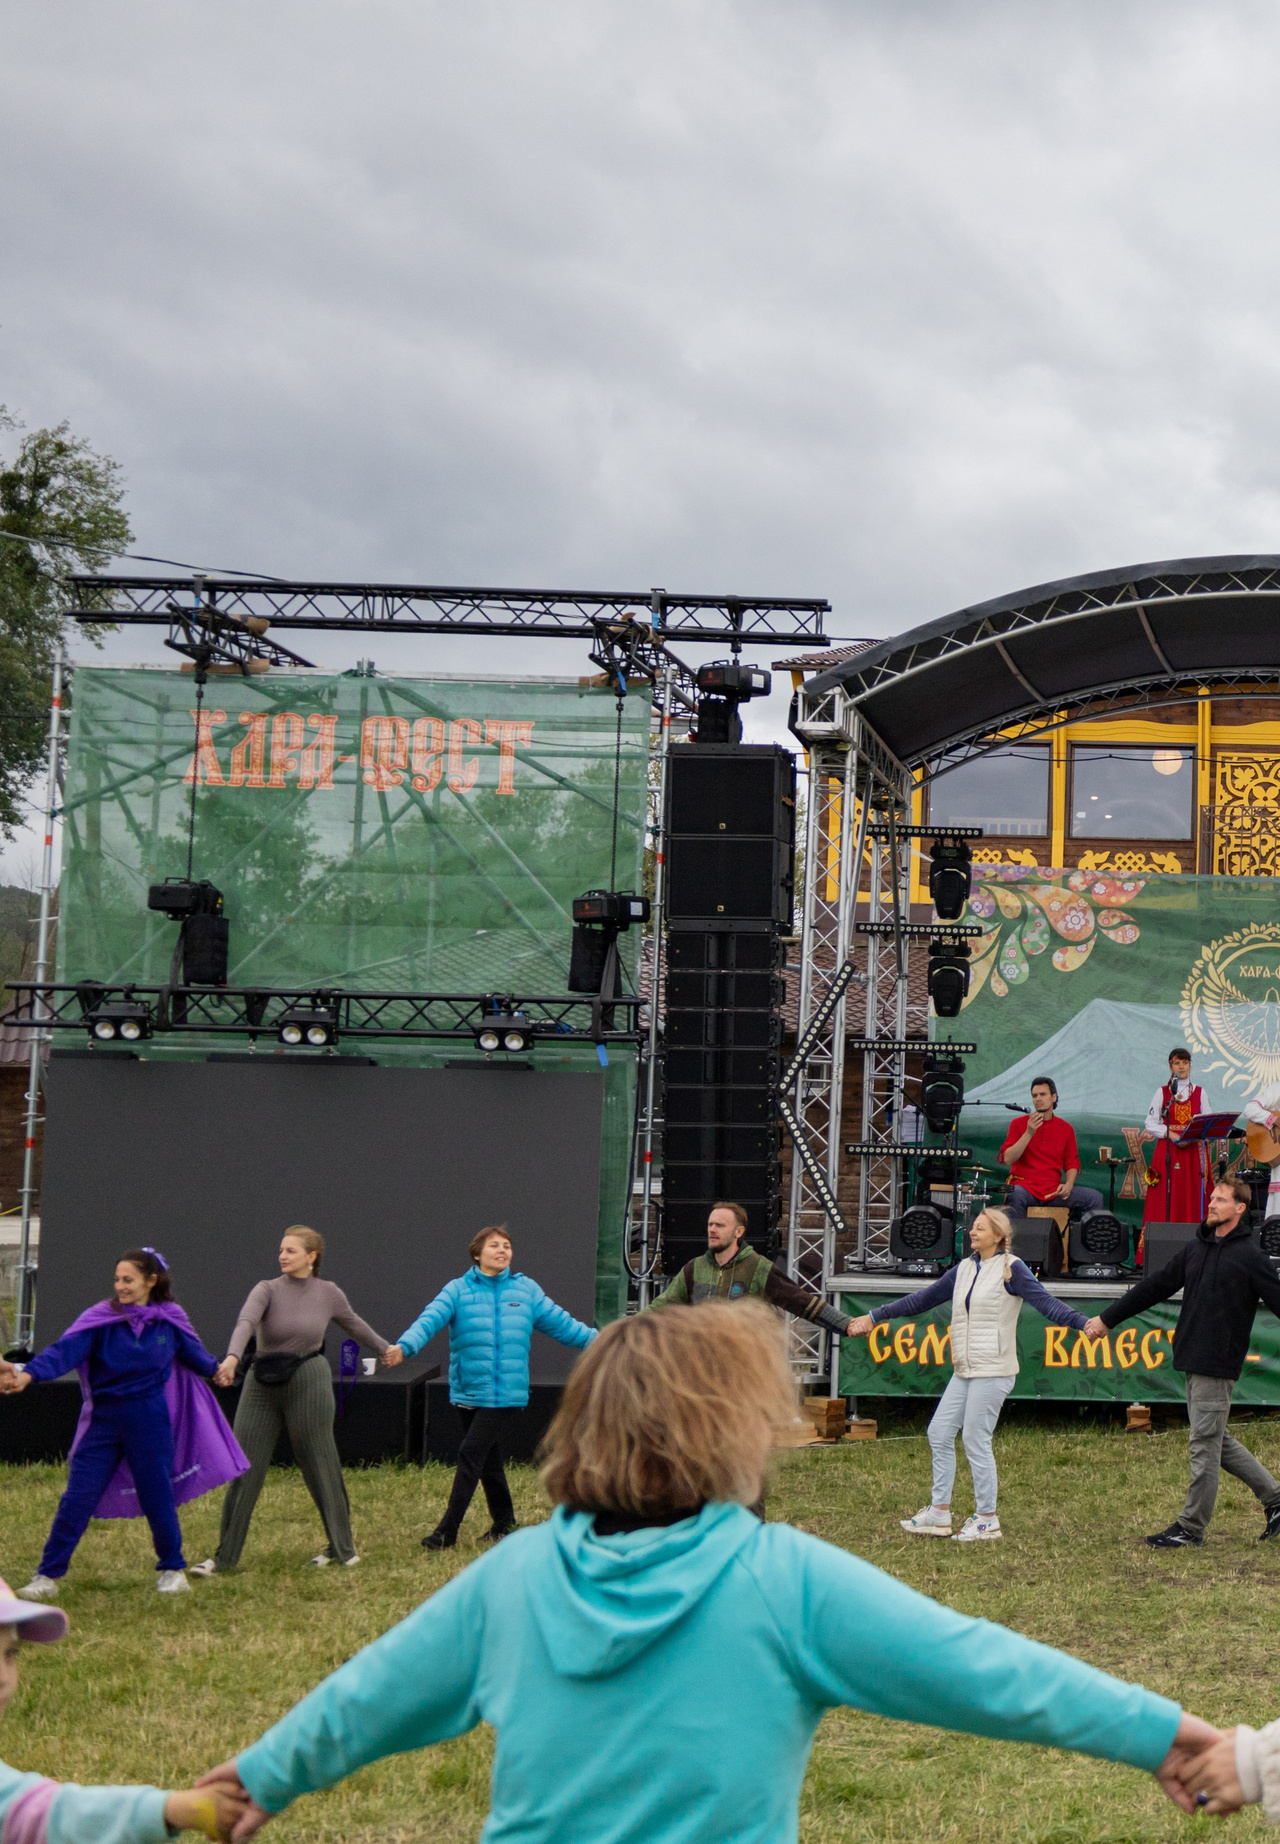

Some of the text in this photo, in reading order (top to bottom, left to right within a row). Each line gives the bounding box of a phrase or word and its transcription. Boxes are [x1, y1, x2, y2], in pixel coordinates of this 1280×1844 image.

[182, 708, 536, 796] ХАРА-ФЕСТ
[868, 1322, 954, 1366] СЕМ
[1045, 1325, 1176, 1370] ВМЕС
